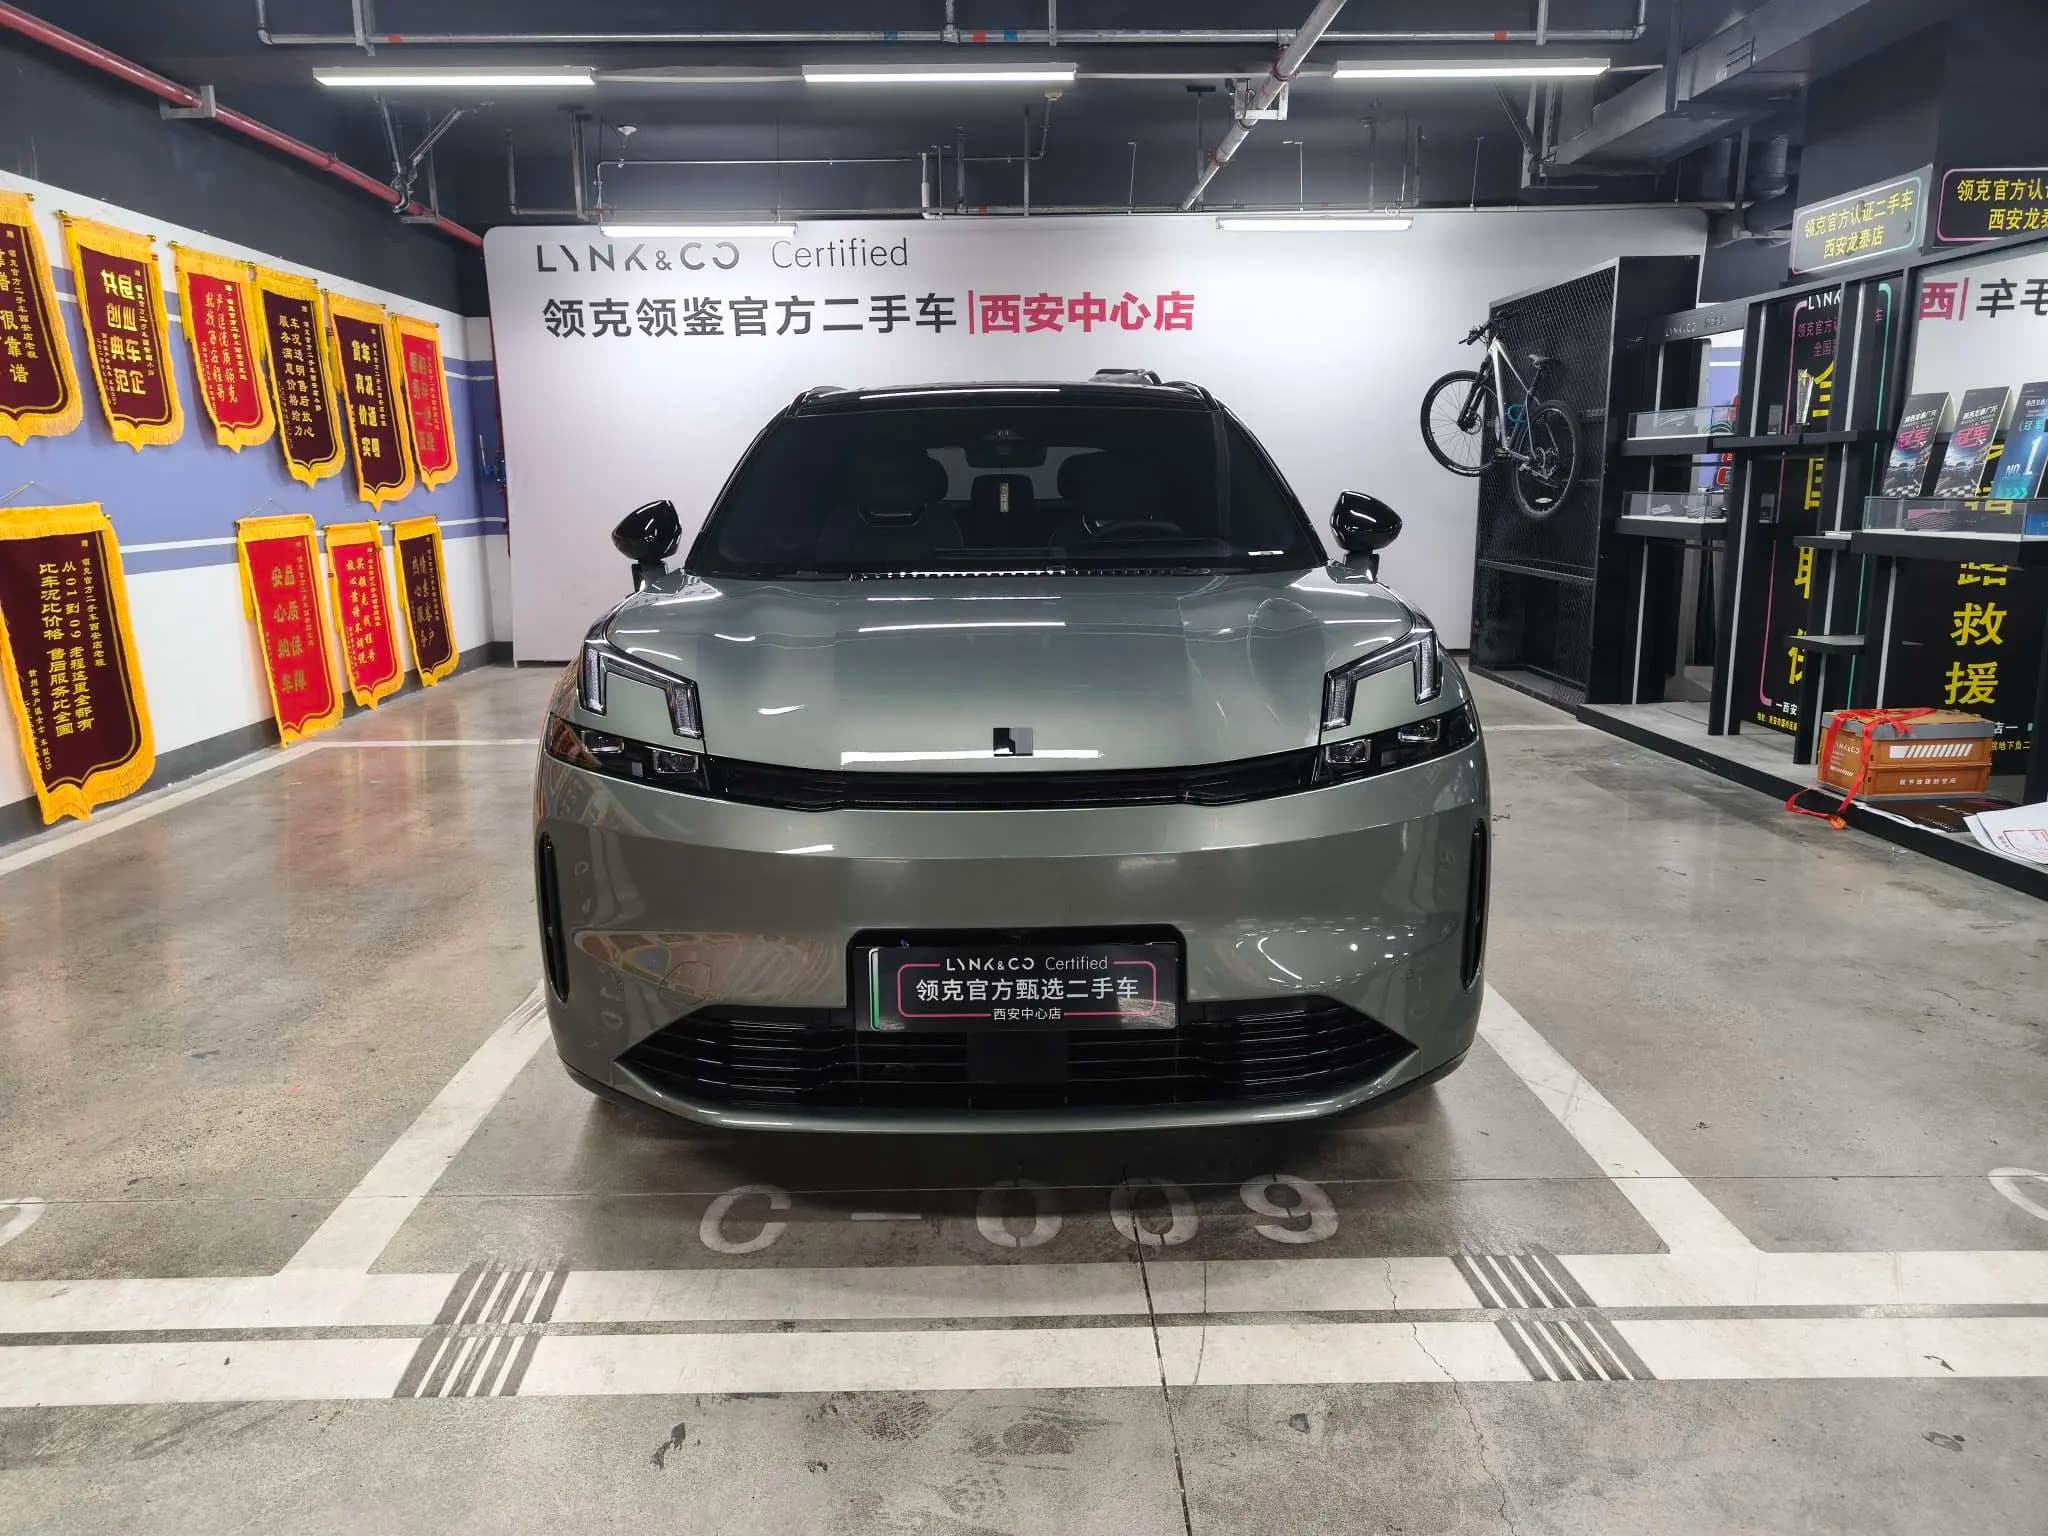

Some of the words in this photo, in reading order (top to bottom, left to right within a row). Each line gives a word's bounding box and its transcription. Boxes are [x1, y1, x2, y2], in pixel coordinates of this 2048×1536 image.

[1957, 178, 2048, 201] 领克官方认
[1805, 189, 1914, 239] 领克官方认证二手车
[537, 242, 740, 272] LYNK&CO
[771, 239, 908, 269] Certified
[1824, 225, 1884, 259] 西安龙泰店
[543, 297, 957, 337] 领克领鉴官方二手车
[980, 291, 1195, 334] 西安中心店
[280, 315, 303, 436] 服务满意价格给力
[290, 318, 315, 437] 车况透明售后放心
[46, 648, 73, 737] 售后服务比全国
[946, 958, 1035, 971] LYNK&CO
[1045, 956, 1108, 971] Certified
[916, 978, 1139, 1001] 领克官方甄选二手车
[993, 1007, 1061, 1021] 西安中心店
